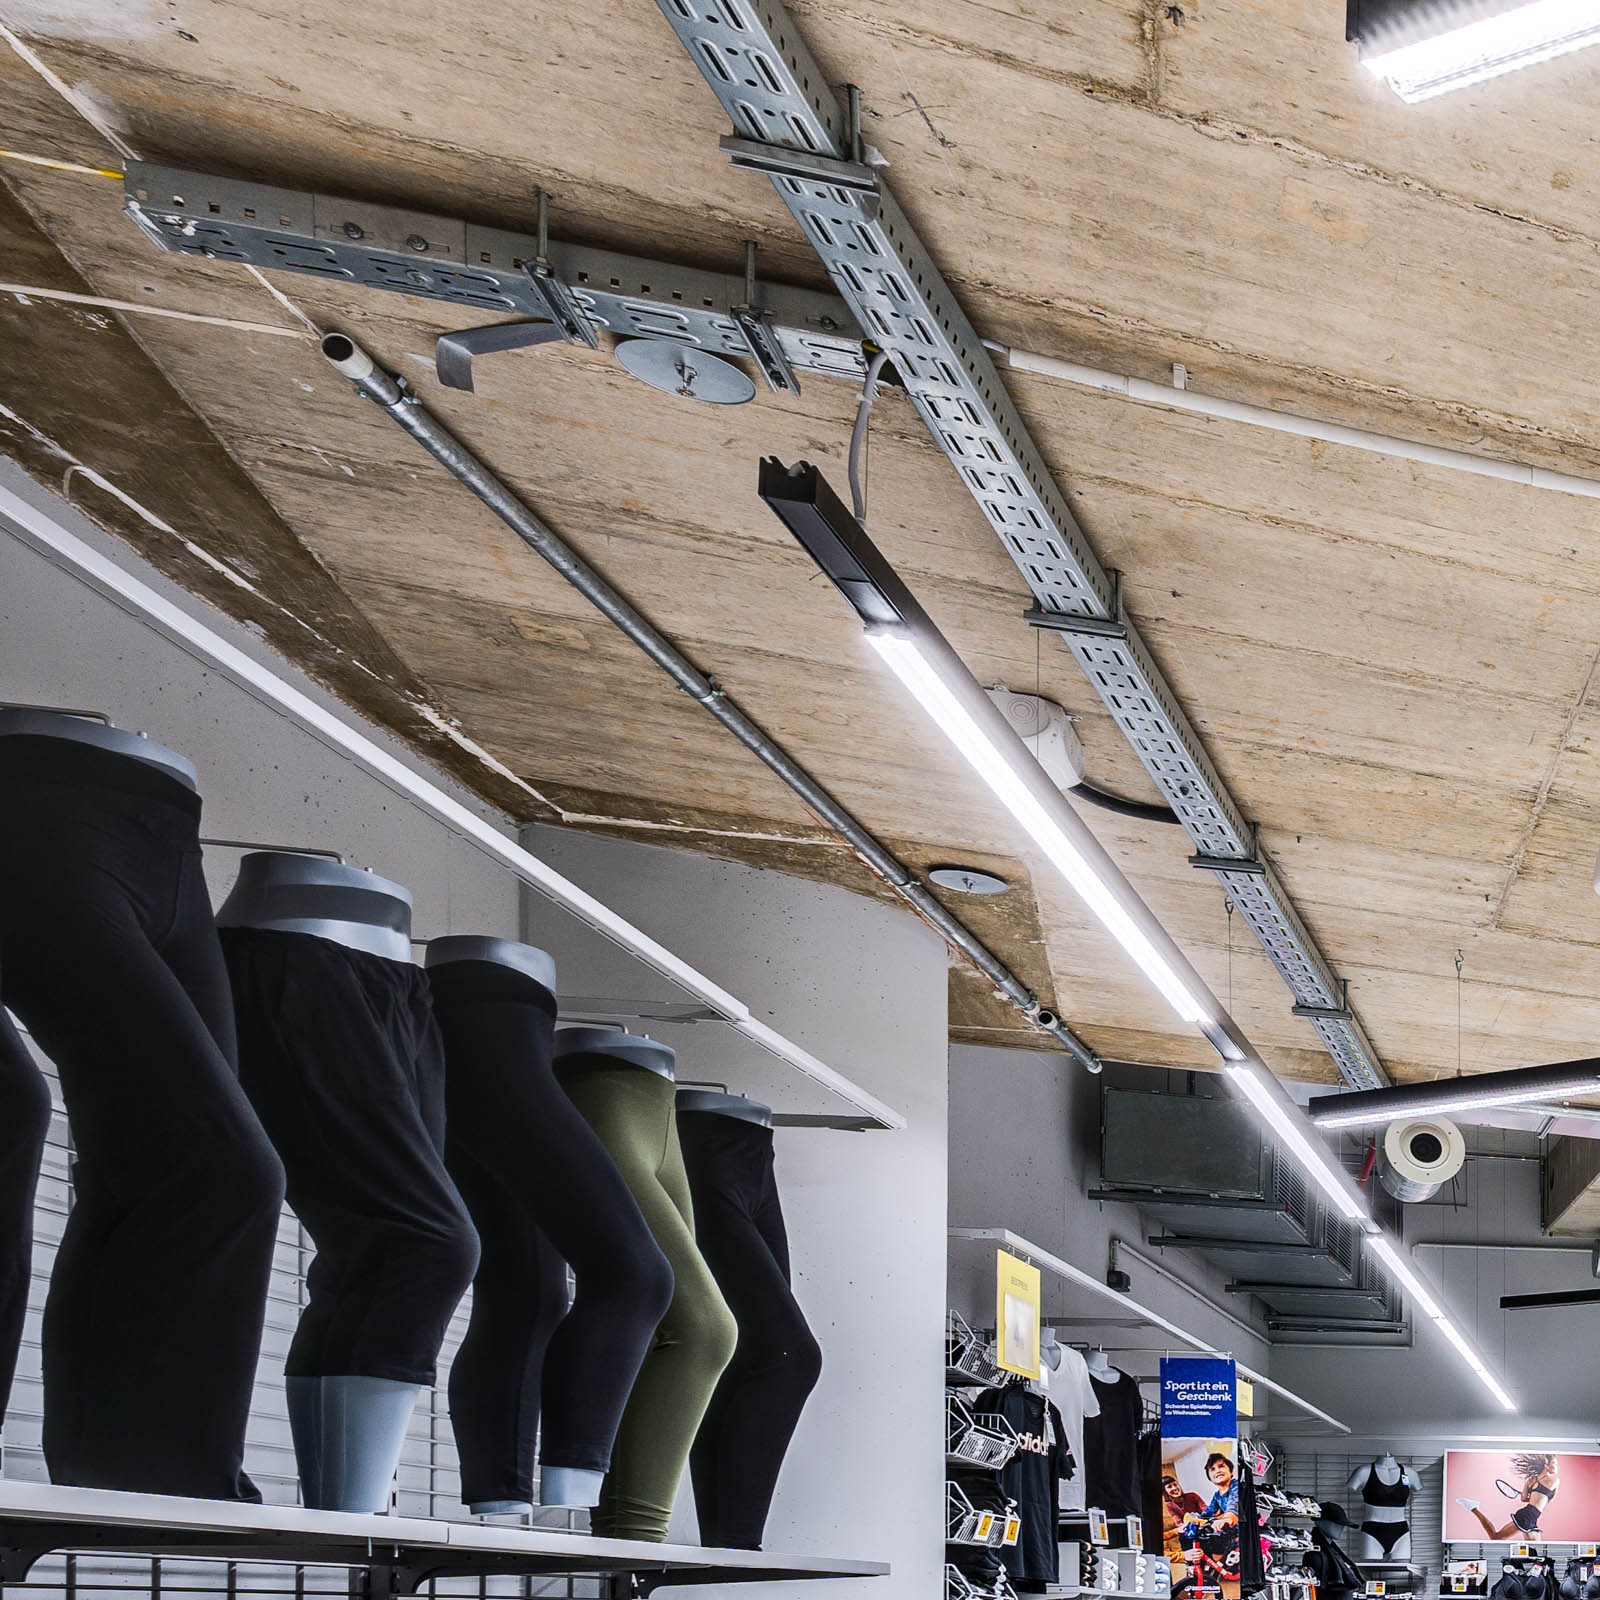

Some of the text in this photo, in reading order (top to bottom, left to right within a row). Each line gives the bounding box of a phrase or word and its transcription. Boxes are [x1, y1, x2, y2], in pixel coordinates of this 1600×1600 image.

[1164, 1380, 1229, 1392] Sport ist ein
[1177, 1391, 1232, 1402] Geschenk
